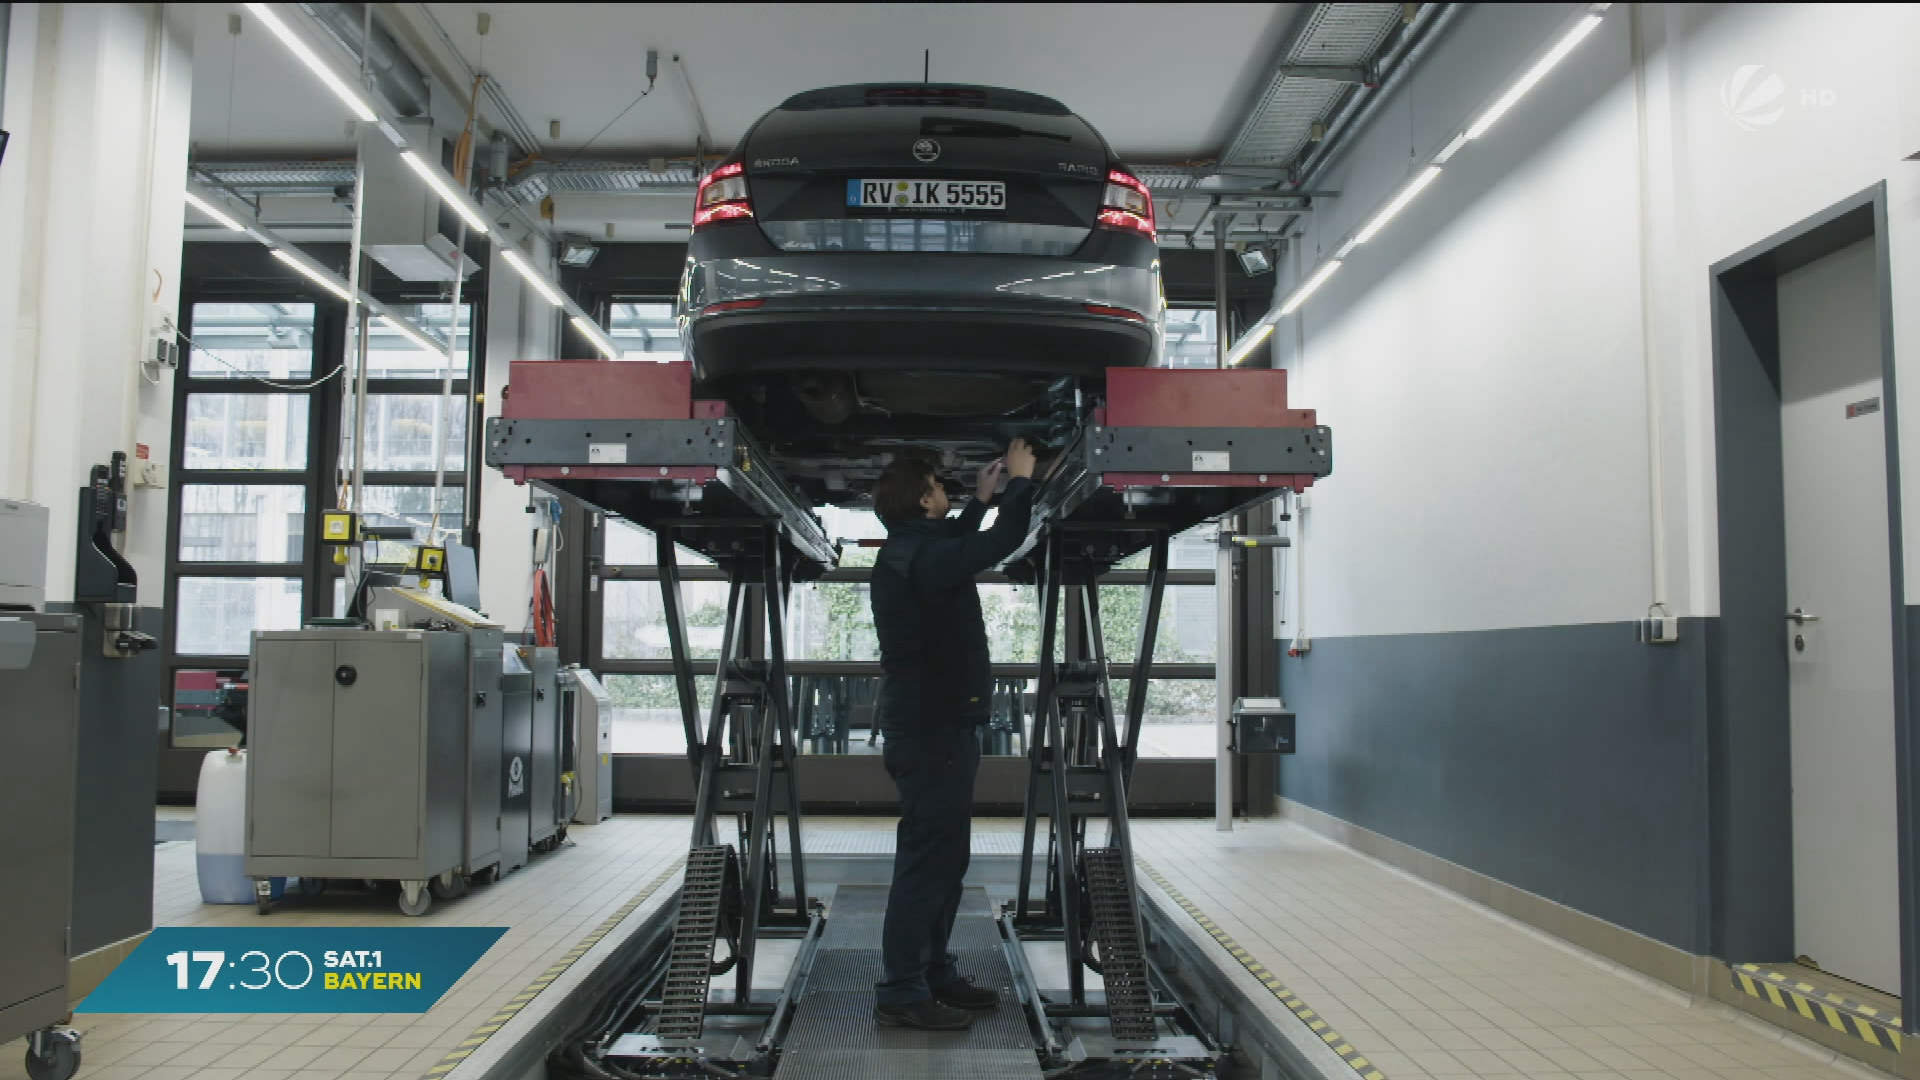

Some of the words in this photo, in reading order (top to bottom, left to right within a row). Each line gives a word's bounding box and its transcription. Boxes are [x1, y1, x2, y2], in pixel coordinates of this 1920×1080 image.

[863, 182, 893, 204] RV
[912, 183, 940, 204] IK
[947, 184, 1003, 206] 5555
